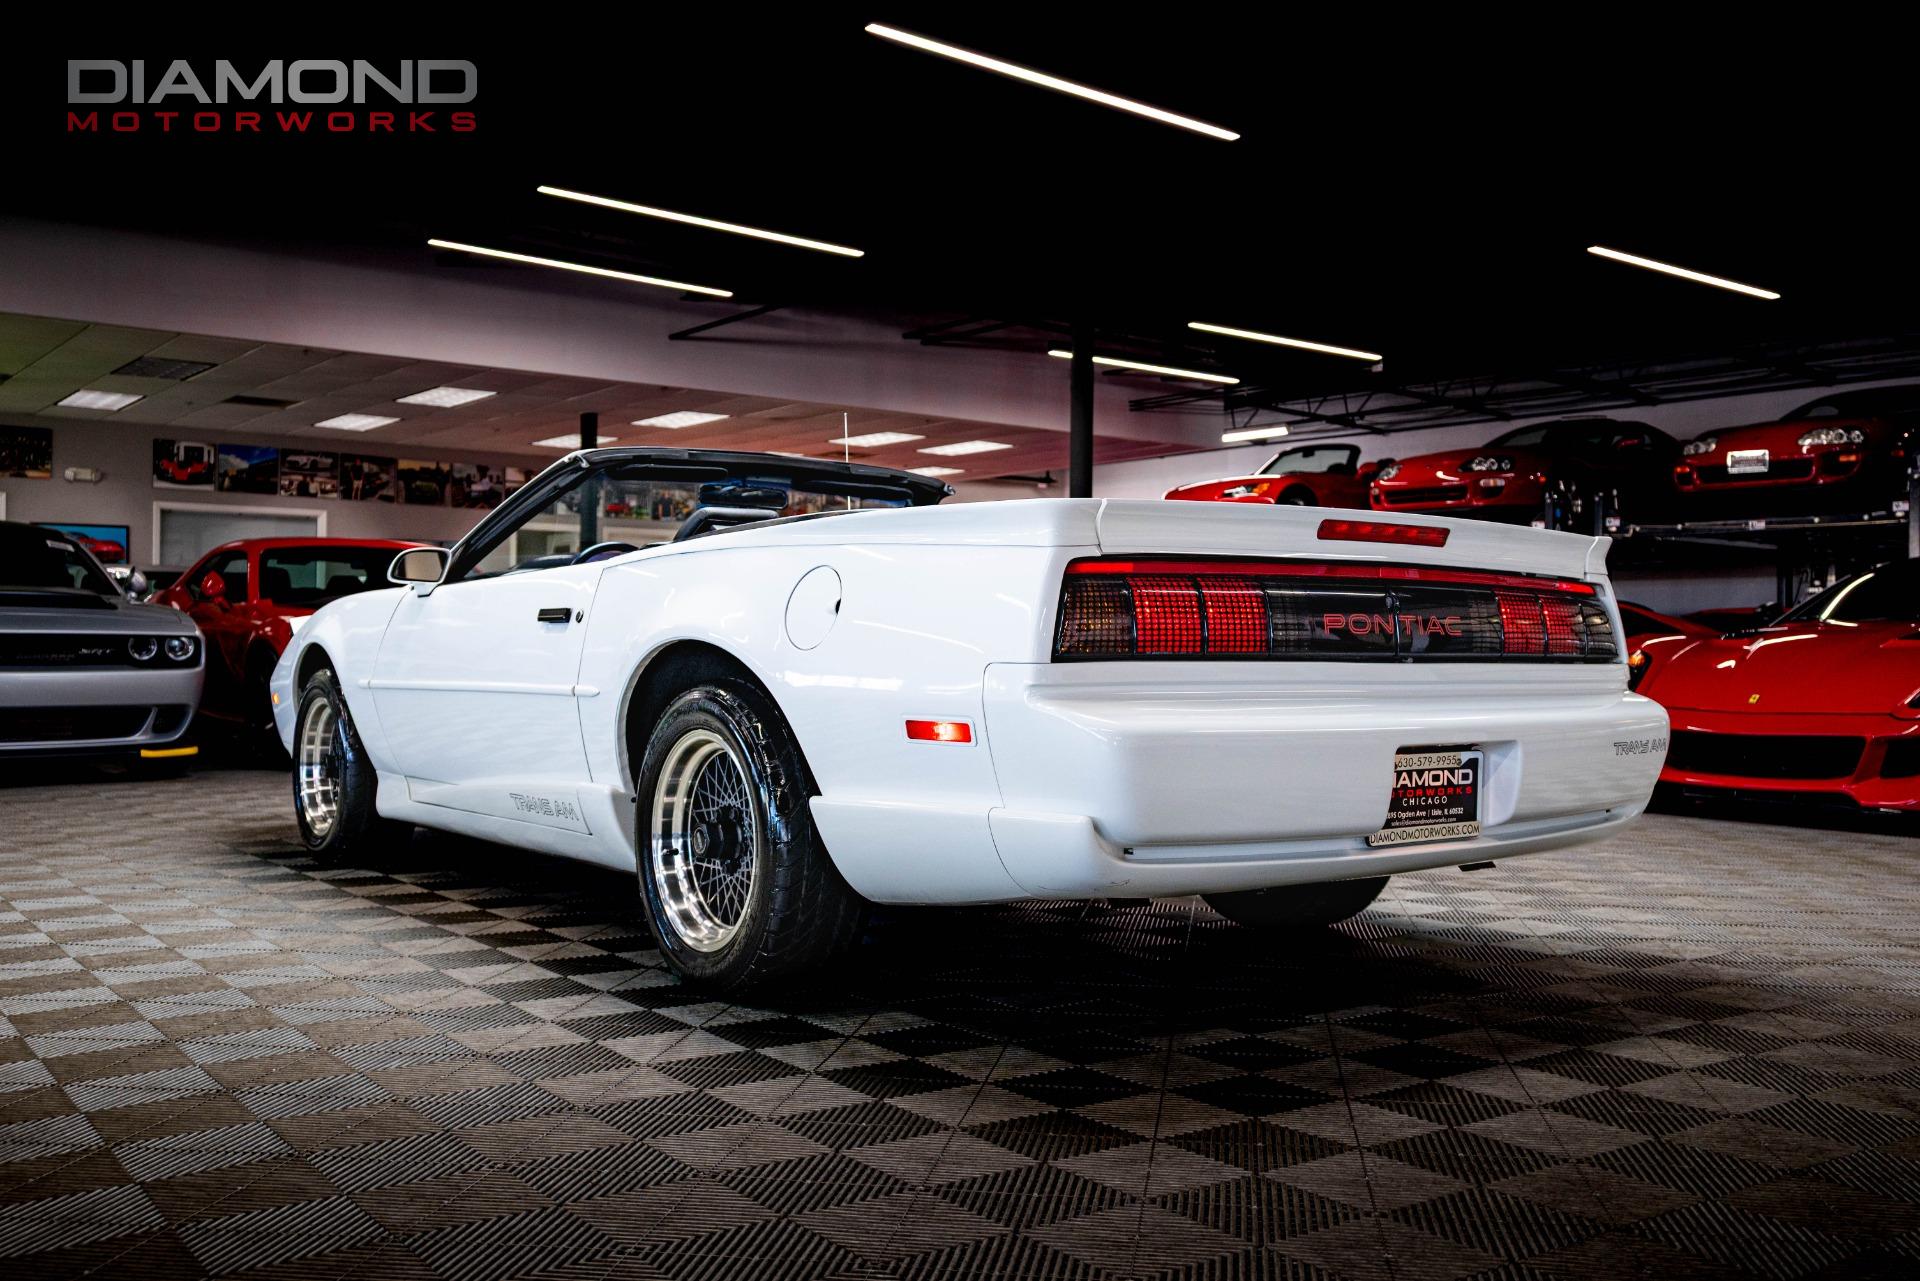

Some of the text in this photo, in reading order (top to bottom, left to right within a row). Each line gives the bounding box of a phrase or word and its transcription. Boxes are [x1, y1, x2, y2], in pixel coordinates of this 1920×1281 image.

[1323, 613, 1463, 636] PONTIAC
[1613, 740, 1650, 756] TRANS
[1397, 755, 1457, 768] 630-579-9955
[1392, 769, 1473, 789] IAMOND
[1391, 786, 1473, 799] TORWORKS
[1402, 796, 1448, 807] CHICAGO
[1397, 811, 1416, 820] Ogden
[1415, 810, 1427, 818] Ave
[1370, 823, 1480, 844] DIAMONDMOTORWORKS.COM
